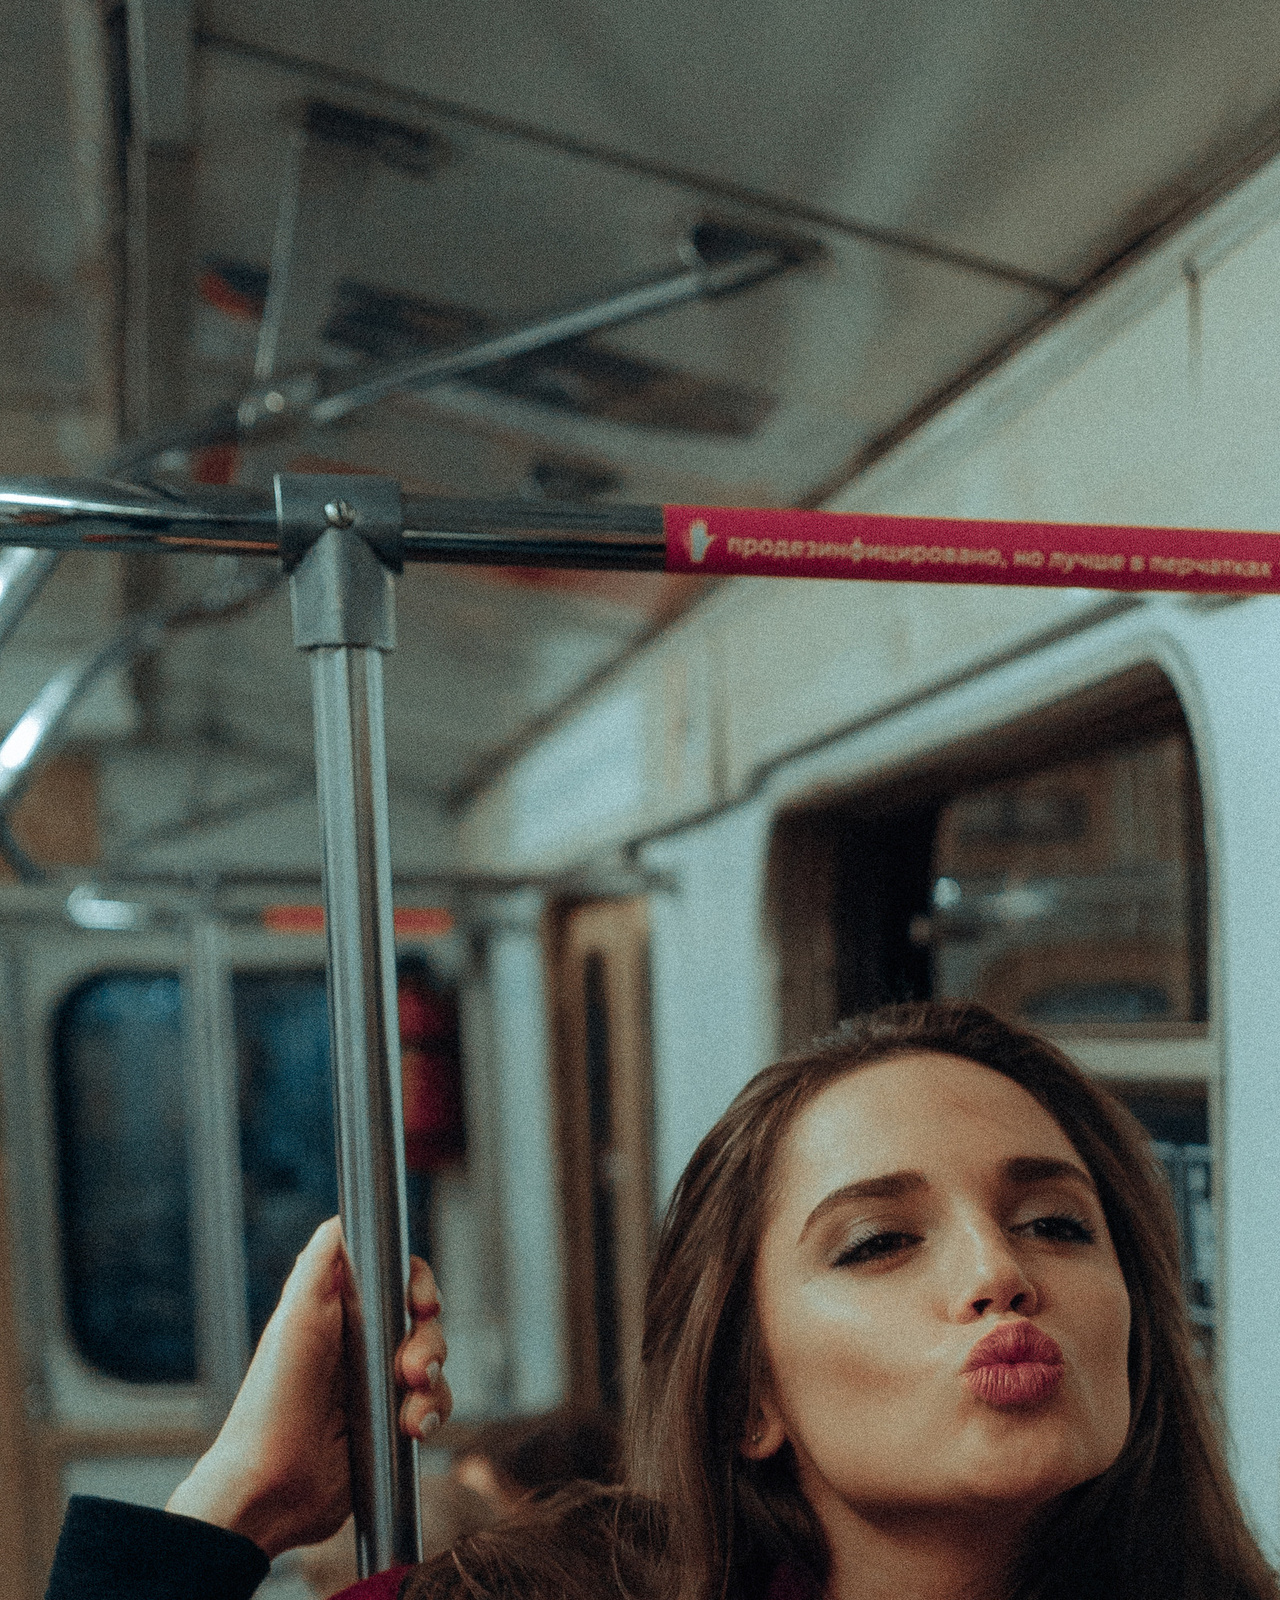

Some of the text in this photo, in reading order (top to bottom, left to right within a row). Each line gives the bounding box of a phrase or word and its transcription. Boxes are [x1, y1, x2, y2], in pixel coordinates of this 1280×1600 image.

[727, 536, 1272, 578] продезинфицировано, но лучше в перчатках
